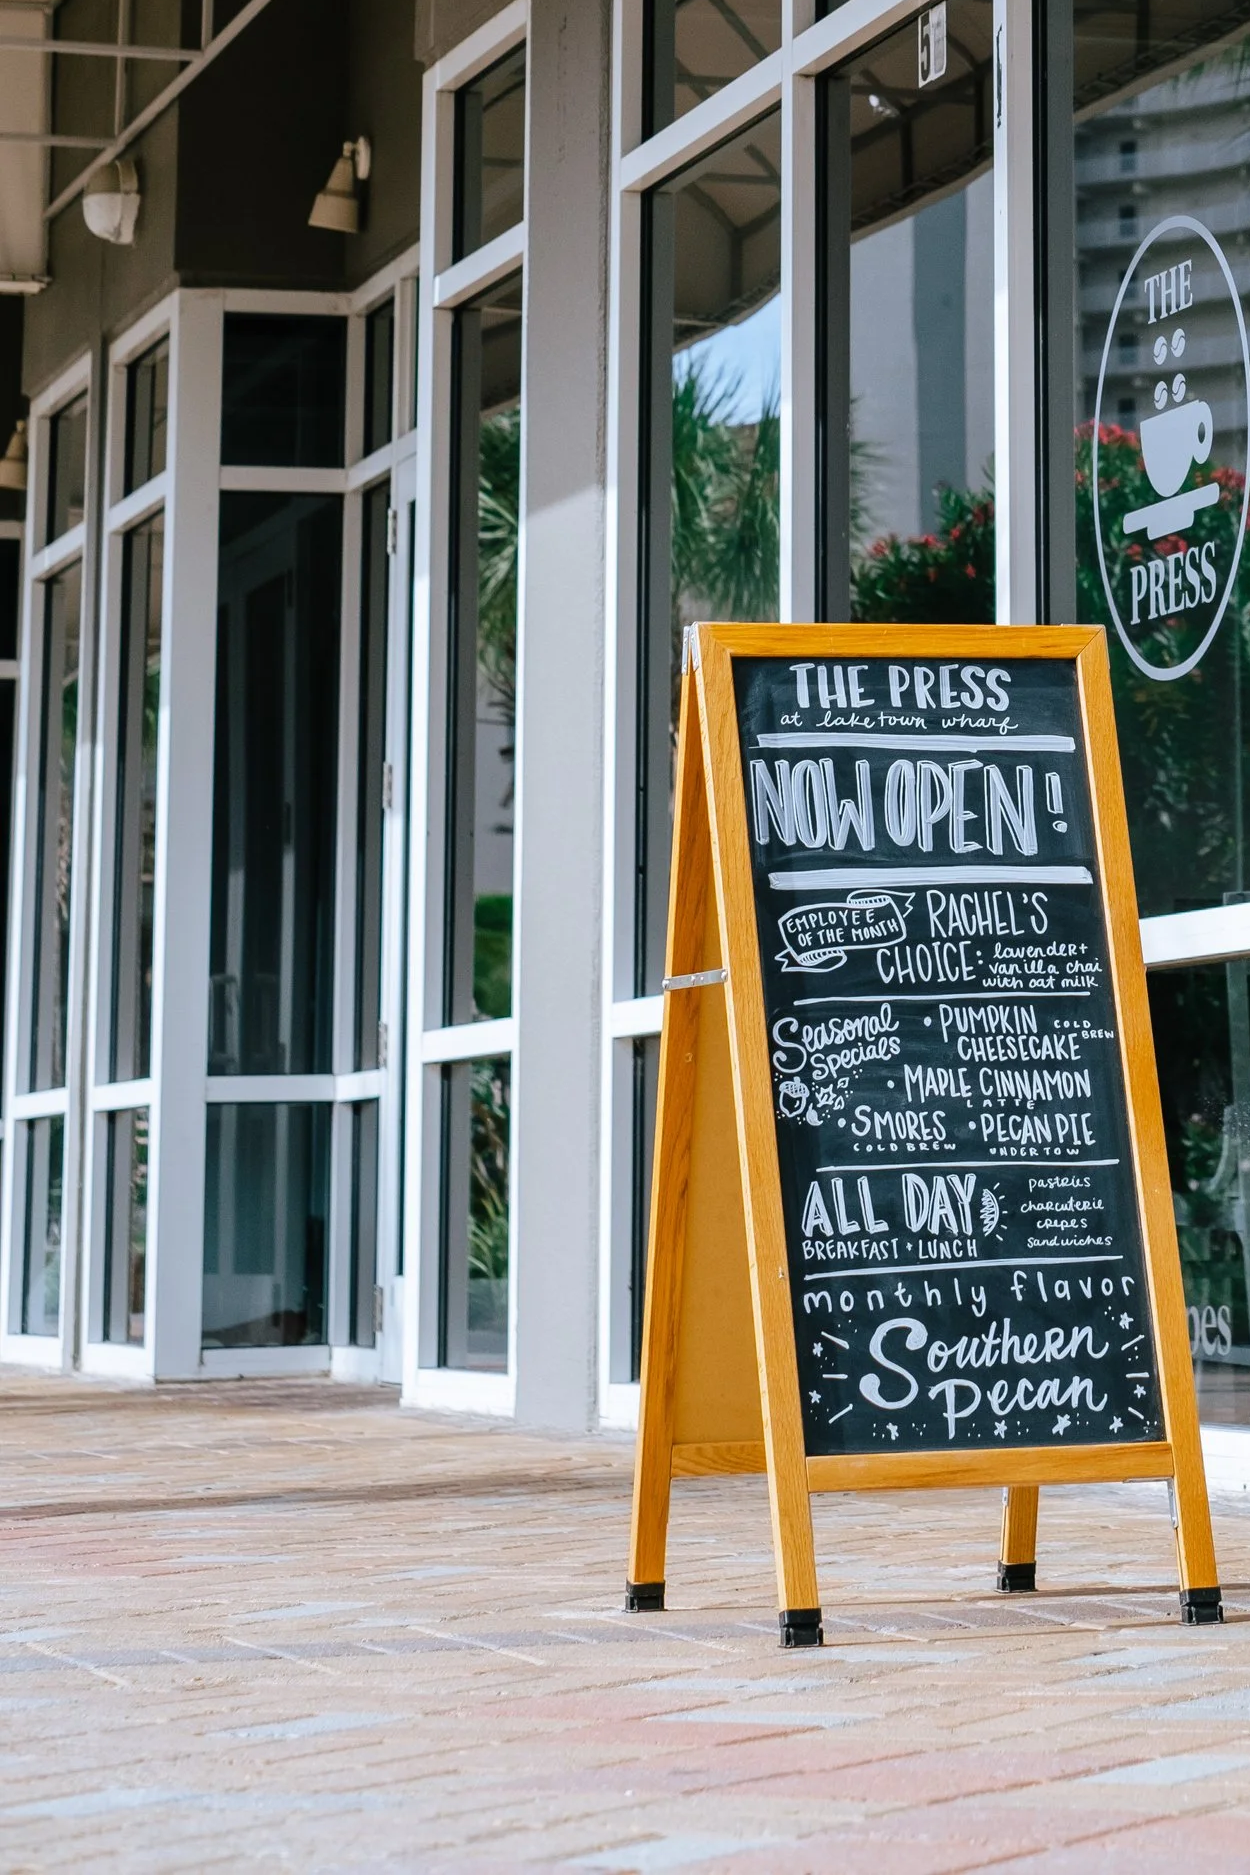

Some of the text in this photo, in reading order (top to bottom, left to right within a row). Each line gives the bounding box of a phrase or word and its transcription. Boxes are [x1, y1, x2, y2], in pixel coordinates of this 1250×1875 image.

[1143, 259, 1193, 325] THE
[1130, 540, 1217, 626] PRESS
[789, 662, 1012, 712] THE PRESS
[780, 711, 803, 726] at
[942, 712, 1019, 735] wharf
[749, 758, 875, 852] NOW
[786, 909, 875, 933] EMPLOYEE
[926, 889, 1049, 939] RACHEL'S
[797, 918, 899, 947] OF THE MONTH
[875, 942, 984, 984] CHOICE:
[989, 958, 1102, 974] vanilla chai
[982, 975, 1098, 989] with oat milk
[772, 1002, 899, 1073] Seasonal
[938, 1003, 1038, 1043] PUMPKIN
[1054, 1019, 1091, 1029] COLD
[1081, 1029, 1114, 1039] BREW
[957, 1032, 1081, 1062] CHEESECAKE
[903, 1064, 1092, 1104] MAPLE CINNAMON
[966, 1099, 1035, 1110] LATTE
[851, 1105, 947, 1141] SMORES
[980, 1112, 1096, 1146] PECAN PIE
[853, 1141, 956, 1152] COLD BREW
[801, 1173, 977, 1237] ALL DAY
[802, 1238, 899, 1260] BREAKFAST
[918, 1239, 978, 1259] LUNCH
[1027, 1235, 1113, 1248] sandwiches
[803, 1270, 1135, 1317] monthly flavor
[859, 1317, 1110, 1410] Southern
[928, 1374, 1108, 1440] Pecan
